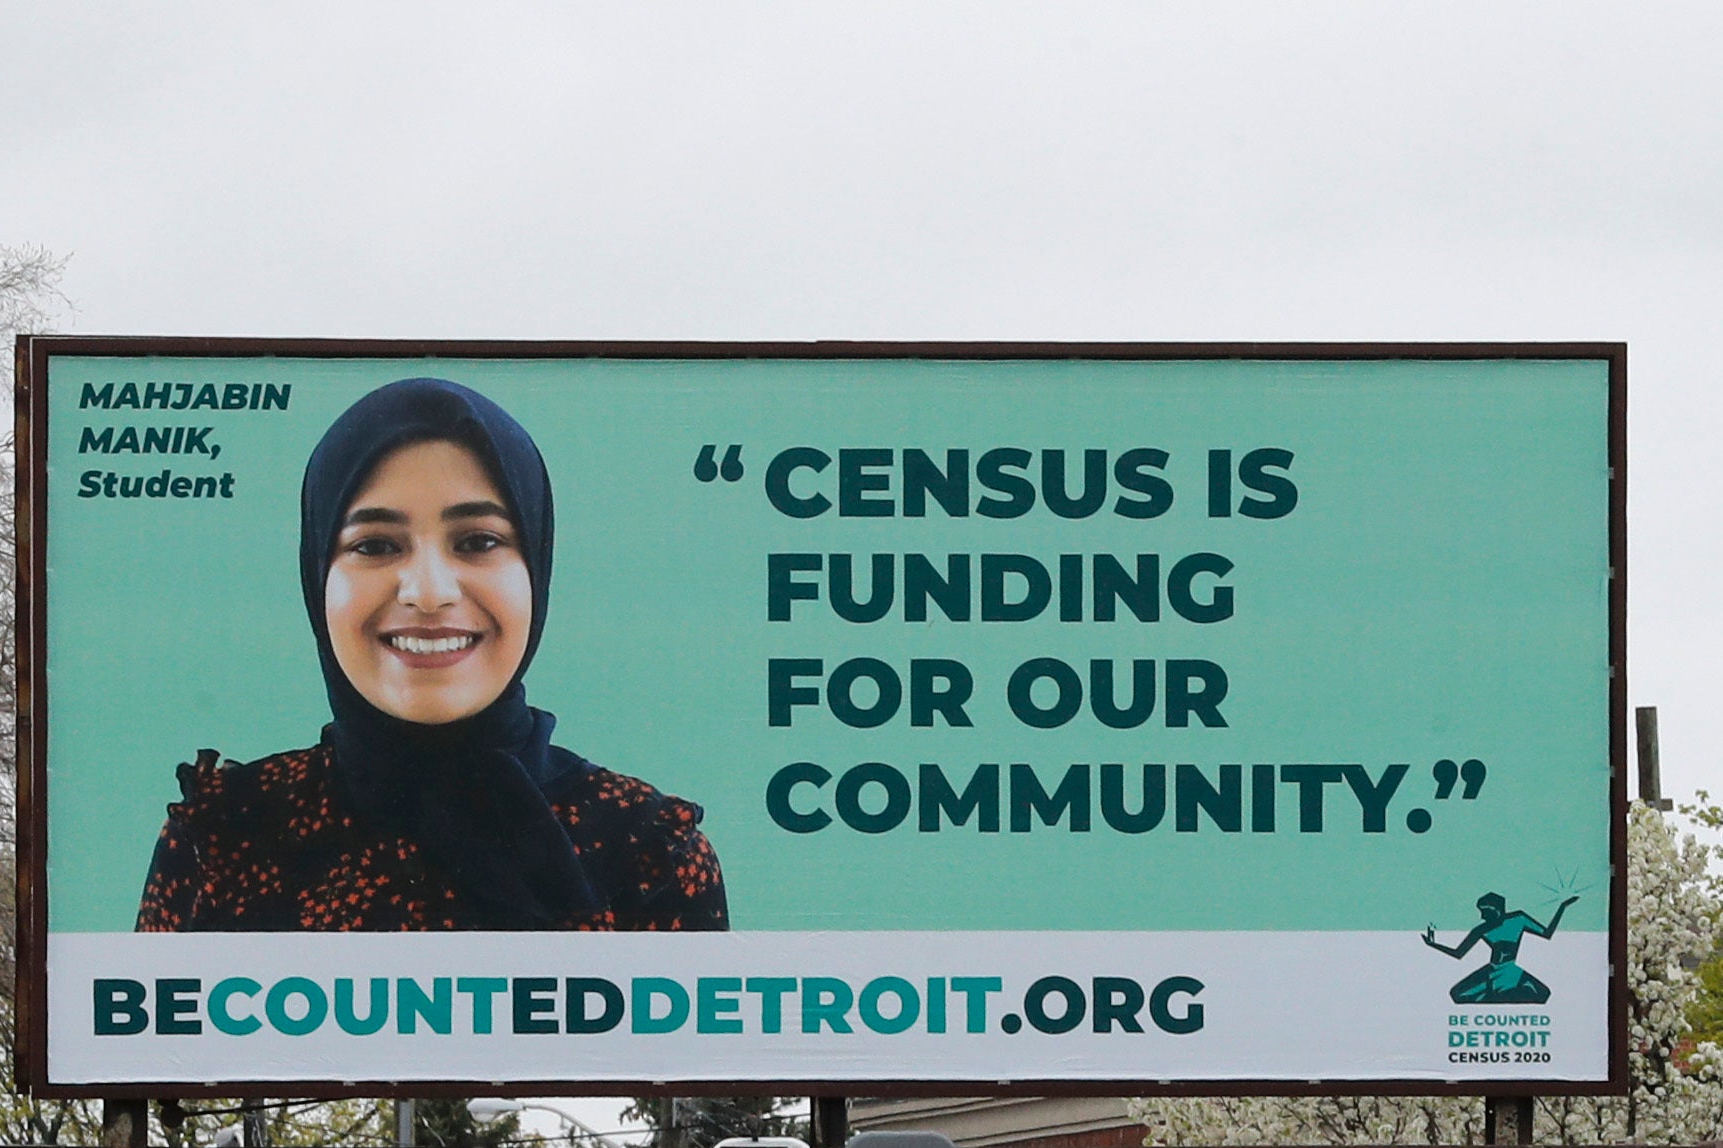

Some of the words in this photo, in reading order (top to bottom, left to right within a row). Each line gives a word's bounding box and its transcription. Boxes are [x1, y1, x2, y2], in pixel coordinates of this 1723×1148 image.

[79, 383, 291, 411] MAHJABIN
[78, 427, 222, 459] MANIK,
[77, 470, 235, 499] Student
[1207, 448, 1299, 519] IS
[766, 552, 1236, 624] FUNDING
[767, 658, 975, 729] FOR
[1006, 658, 1229, 729] OUR
[765, 759, 1488, 834] COMMUNITY.”
[93, 975, 1205, 1036] BECOUNTEDDETROIT.ORG
[1448, 1015, 1468, 1026] BE
[1474, 1015, 1550, 1026] COUNTED
[1448, 1031, 1551, 1048] DETROIT
[1448, 1052, 1510, 1064] CENSUS
[1514, 1052, 1551, 1063] 2020
